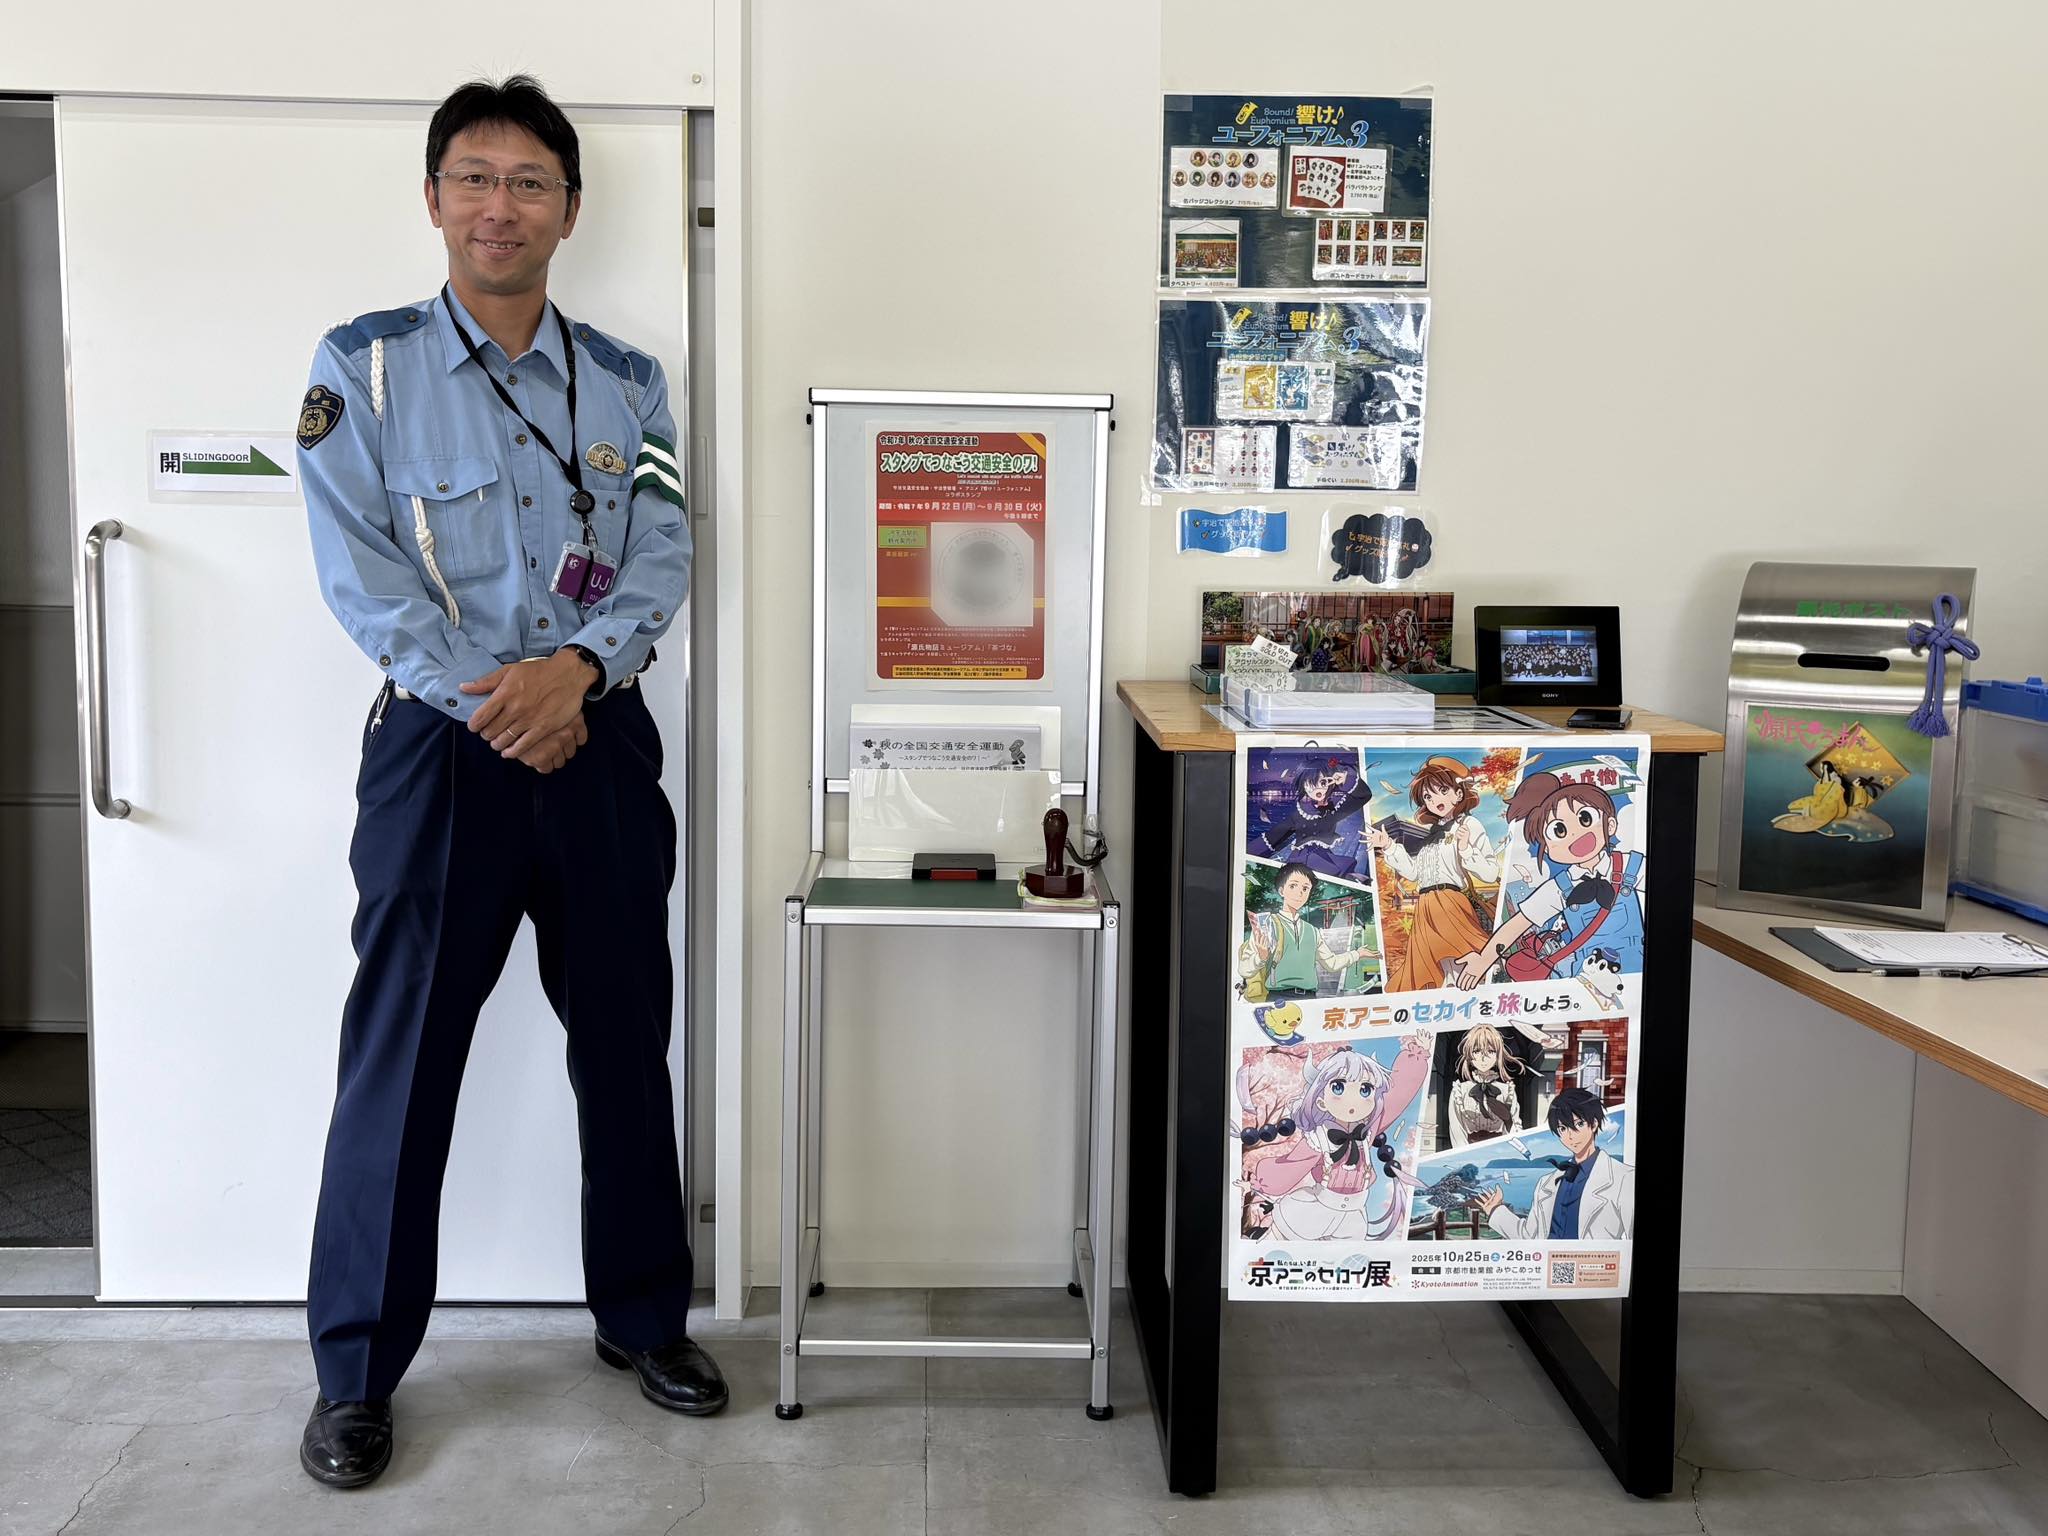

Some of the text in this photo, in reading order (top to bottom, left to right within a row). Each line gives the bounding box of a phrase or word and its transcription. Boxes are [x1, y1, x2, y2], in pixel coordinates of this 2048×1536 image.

[1250, 117, 1296, 126] Euphonium
[160, 452, 181, 474] 開
[182, 453, 249, 462] SLIDINGDOOR
[1260, 646, 1292, 665] SOLD OUT
[879, 739, 1005, 751] 秋の全国交通安全運動
[1322, 992, 1581, 1030] 京アニのセカイを旅しよう。
[1247, 1257, 1393, 1288] 京アニのセカイ展
